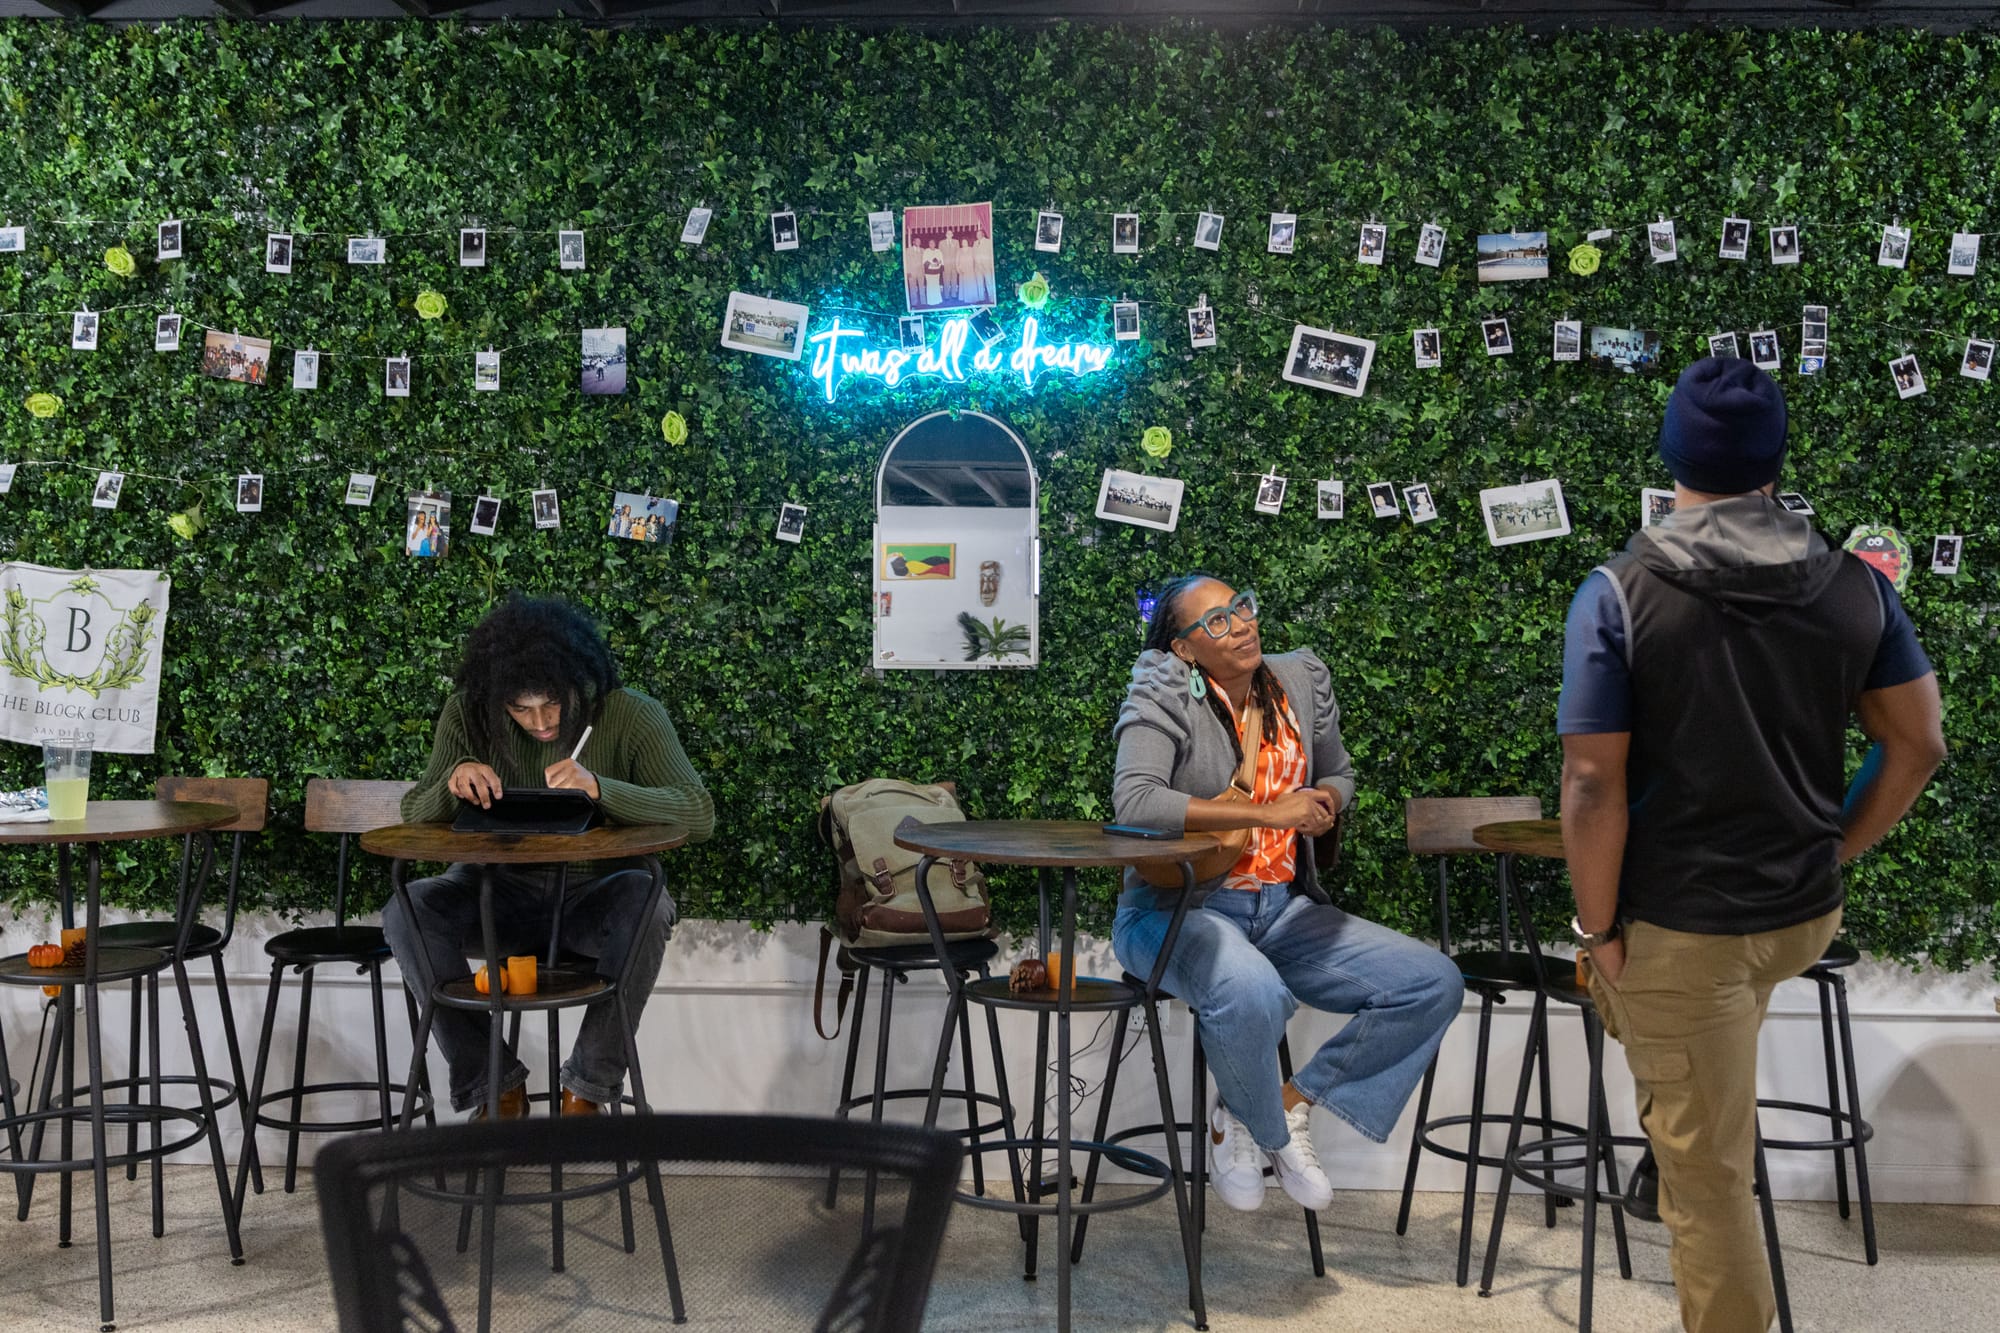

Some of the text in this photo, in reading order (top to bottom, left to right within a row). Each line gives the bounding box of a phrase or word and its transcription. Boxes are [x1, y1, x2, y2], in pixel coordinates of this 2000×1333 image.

[841, 346, 908, 386] was
[917, 318, 968, 380] all
[974, 345, 1002, 371] a
[1011, 316, 1112, 385] dream
[65, 607, 92, 652] B
[34, 700, 86, 720] BLOCK
[92, 707, 140, 723] CLUB
[33, 727, 96, 740] SAN DIGO
